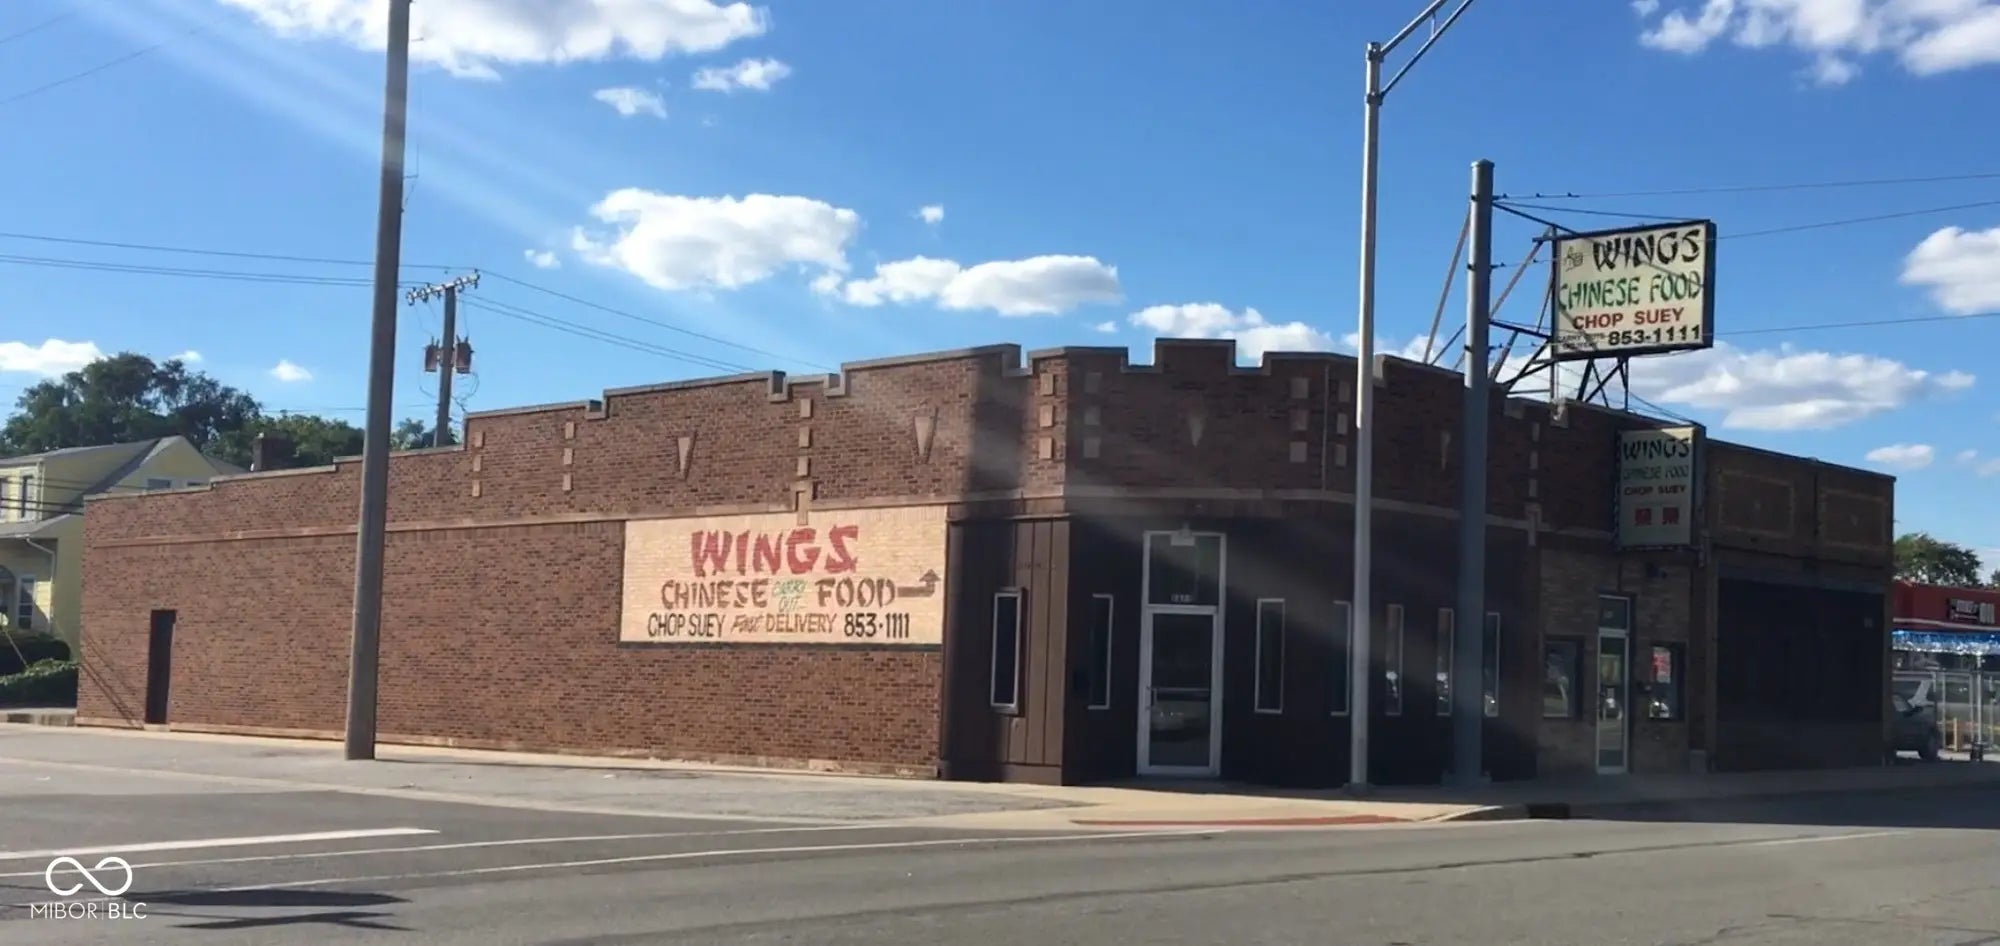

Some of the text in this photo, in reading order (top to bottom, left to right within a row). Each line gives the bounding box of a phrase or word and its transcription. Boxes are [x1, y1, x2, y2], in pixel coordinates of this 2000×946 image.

[1593, 230, 1701, 271] WINGS
[1558, 271, 1702, 309] CHINESE FOOD
[1572, 307, 1685, 330] CHOP SUEY
[1608, 324, 1701, 346] 853-1111
[1623, 438, 1690, 460] WINGS
[691, 524, 859, 577] WINGS
[661, 578, 769, 610] CHINESE
[814, 577, 896, 609] FOOD
[647, 613, 687, 638] CHOP
[688, 612, 725, 638] SUEY
[765, 613, 838, 633] DELIVERY
